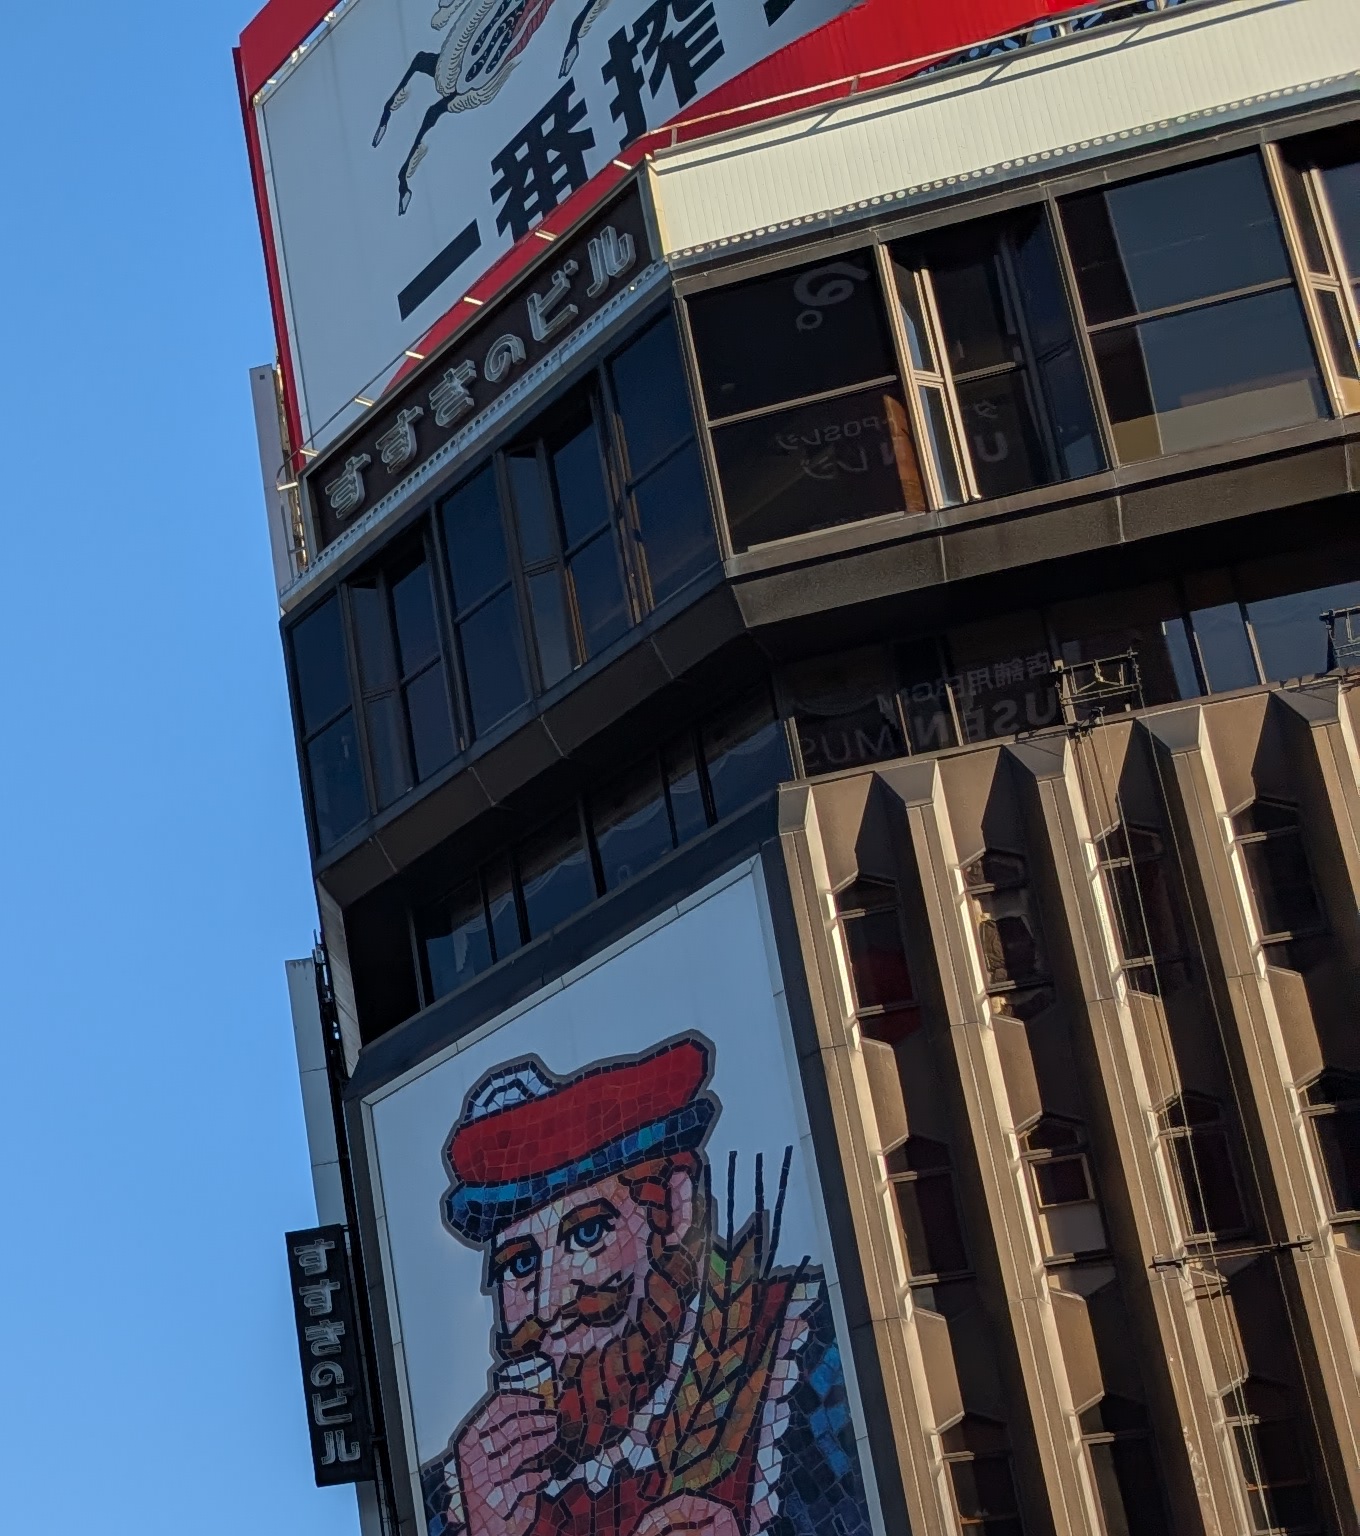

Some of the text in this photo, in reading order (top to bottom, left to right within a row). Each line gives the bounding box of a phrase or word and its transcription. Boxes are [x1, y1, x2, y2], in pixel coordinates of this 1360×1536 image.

[397, 0, 796, 321] 一番搾
[325, 225, 636, 519] すすきのビル
[294, 1238, 361, 1465] すすきのビル
